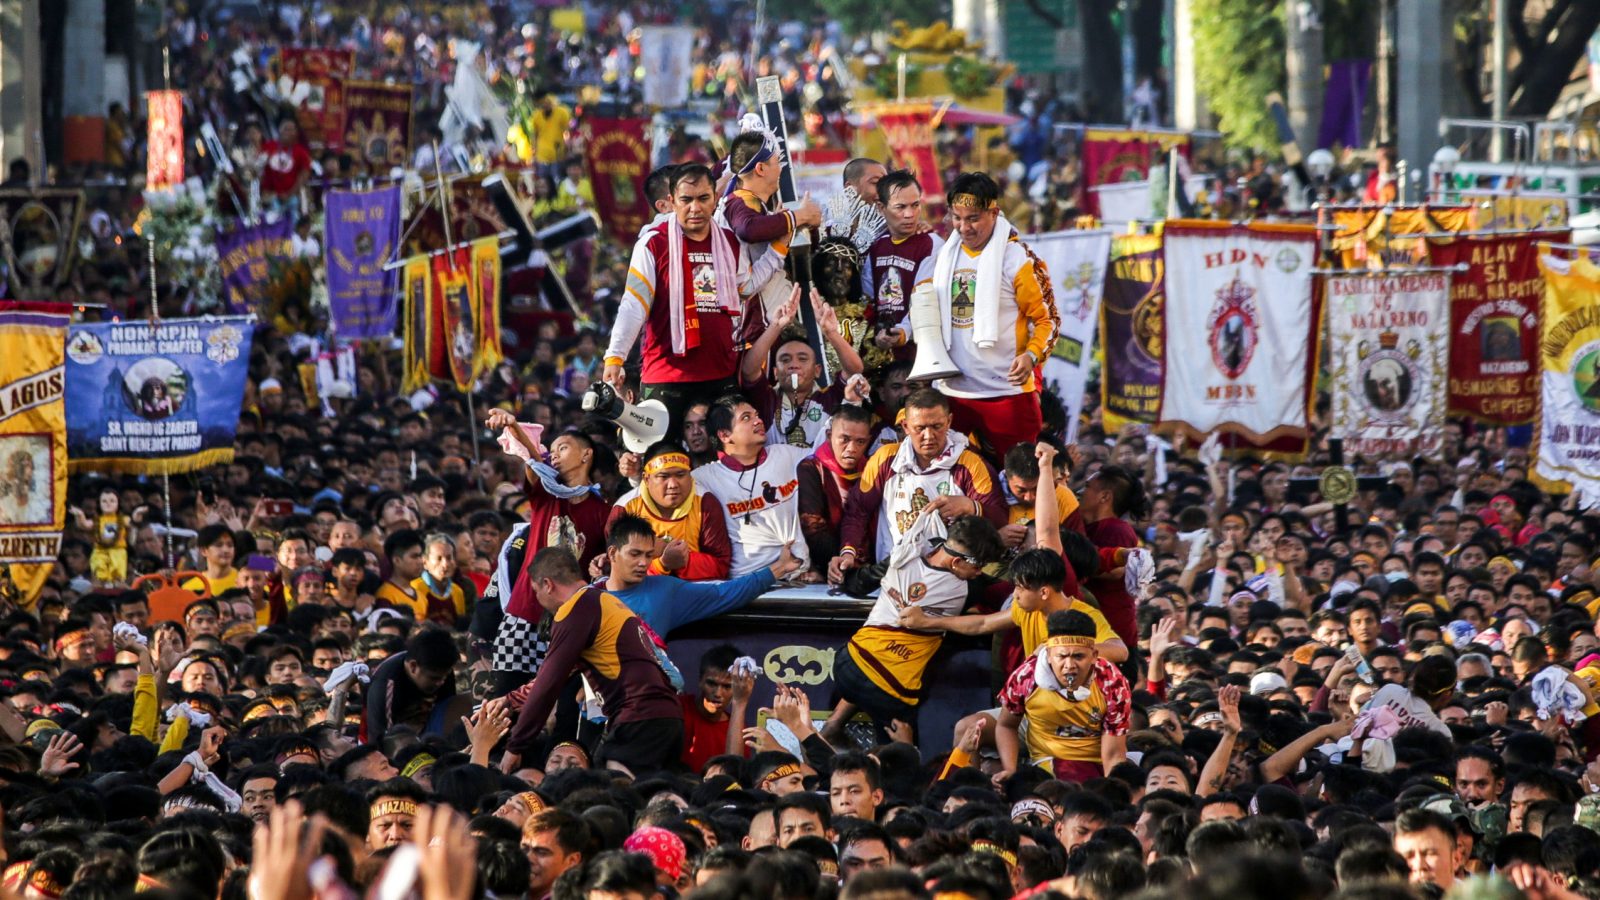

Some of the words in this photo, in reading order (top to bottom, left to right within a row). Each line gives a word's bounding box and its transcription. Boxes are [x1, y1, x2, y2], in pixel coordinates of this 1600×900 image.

[1204, 248, 1270, 269] HDN
[1472, 244, 1517, 264] ALAY
[1483, 264, 1508, 282] SA
[1350, 310, 1428, 329] NAZARENO
[158, 340, 203, 354] CHAPTER
[1479, 361, 1529, 374] NAZARENO
[11, 371, 62, 411] AGOS
[101, 436, 128, 451] SAINT
